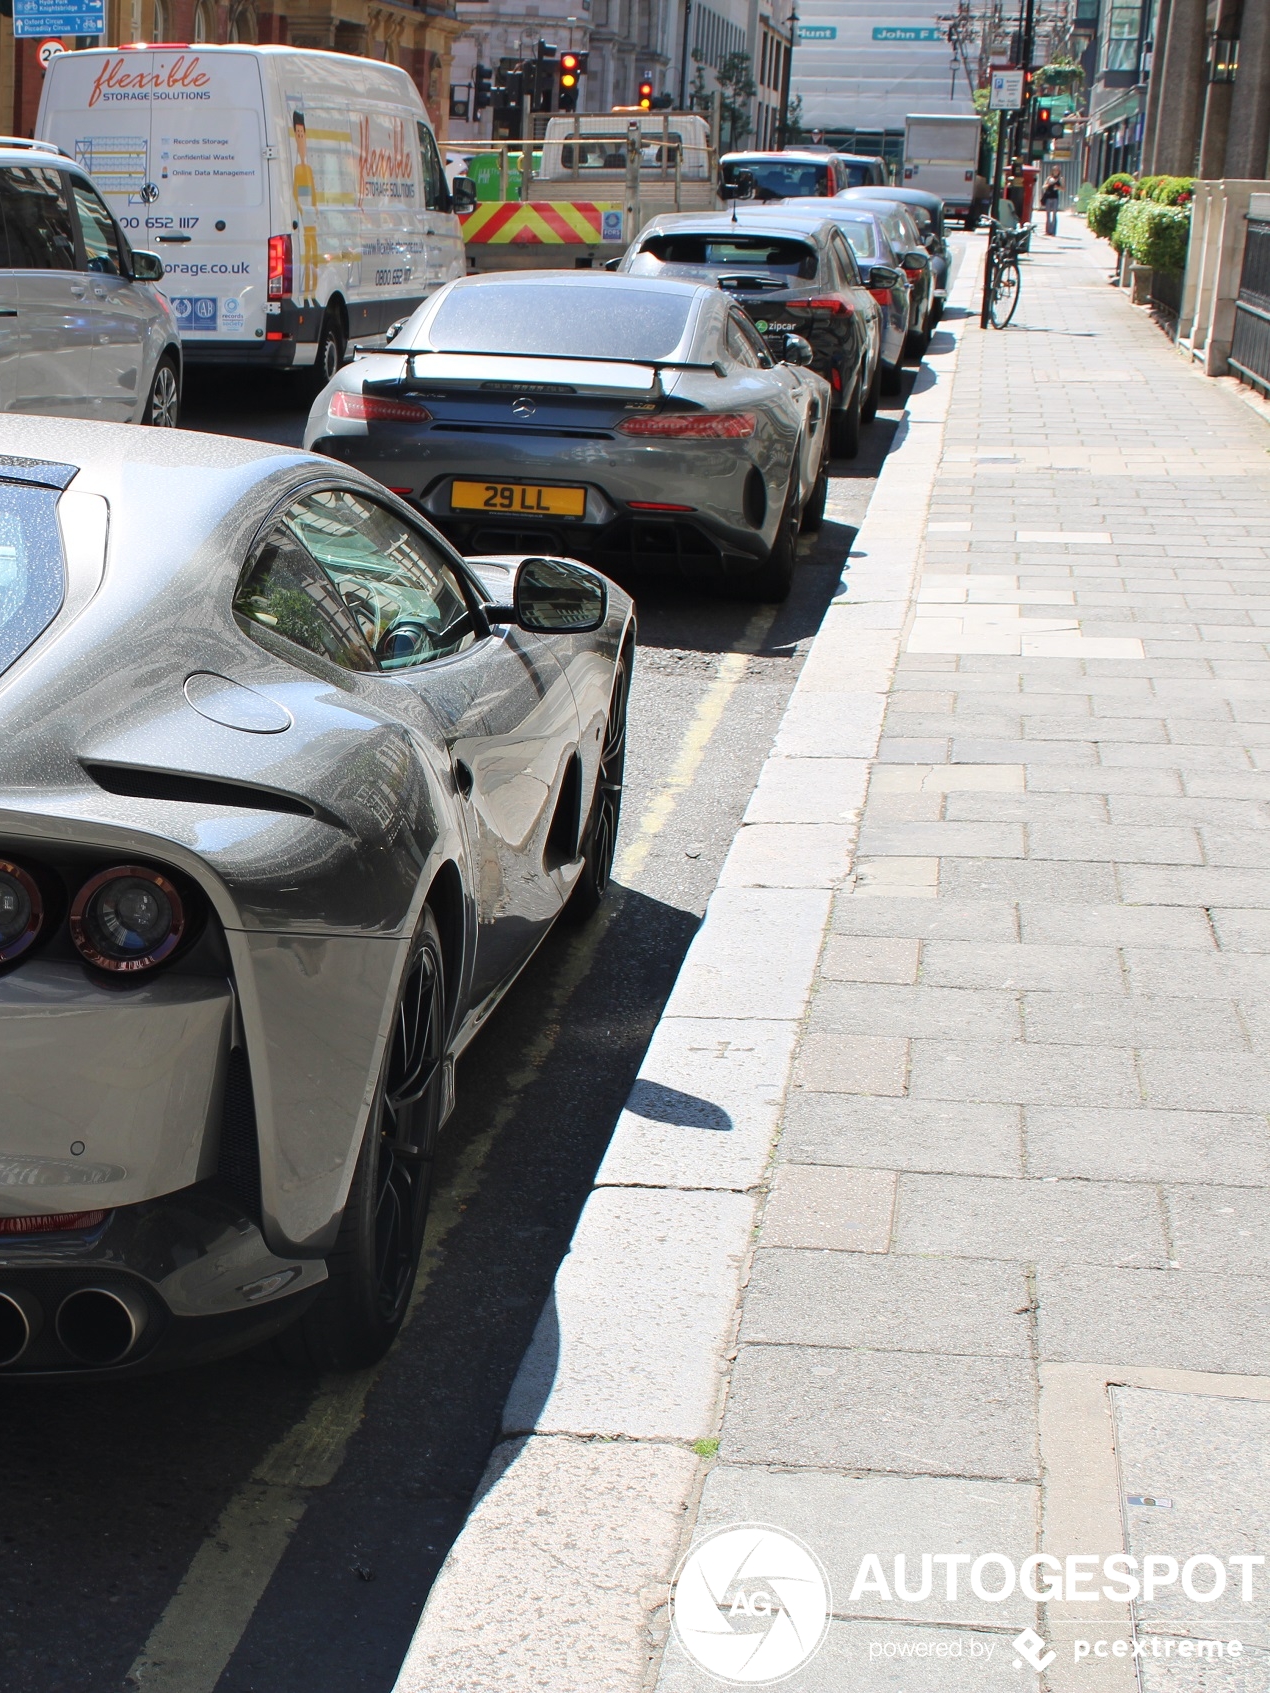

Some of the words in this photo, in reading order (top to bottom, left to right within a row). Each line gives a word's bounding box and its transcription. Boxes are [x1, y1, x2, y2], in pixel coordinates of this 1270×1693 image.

[797, 28, 831, 38] Hunt
[877, 29, 915, 39] John
[920, 30, 929, 39] F
[42, 48, 62, 61] 2
[88, 55, 211, 108] flexible
[103, 91, 150, 101] STORAGE
[153, 91, 211, 100] SOLUTIONS
[202, 138, 228, 146] Storage
[212, 169, 255, 177] Management
[145, 217, 174, 229] 652
[179, 217, 200, 229] 1117
[163, 261, 251, 276] orage.co.uk
[768, 321, 797, 332] zipcar
[483, 485, 515, 509] 29
[520, 487, 550, 511] LL
